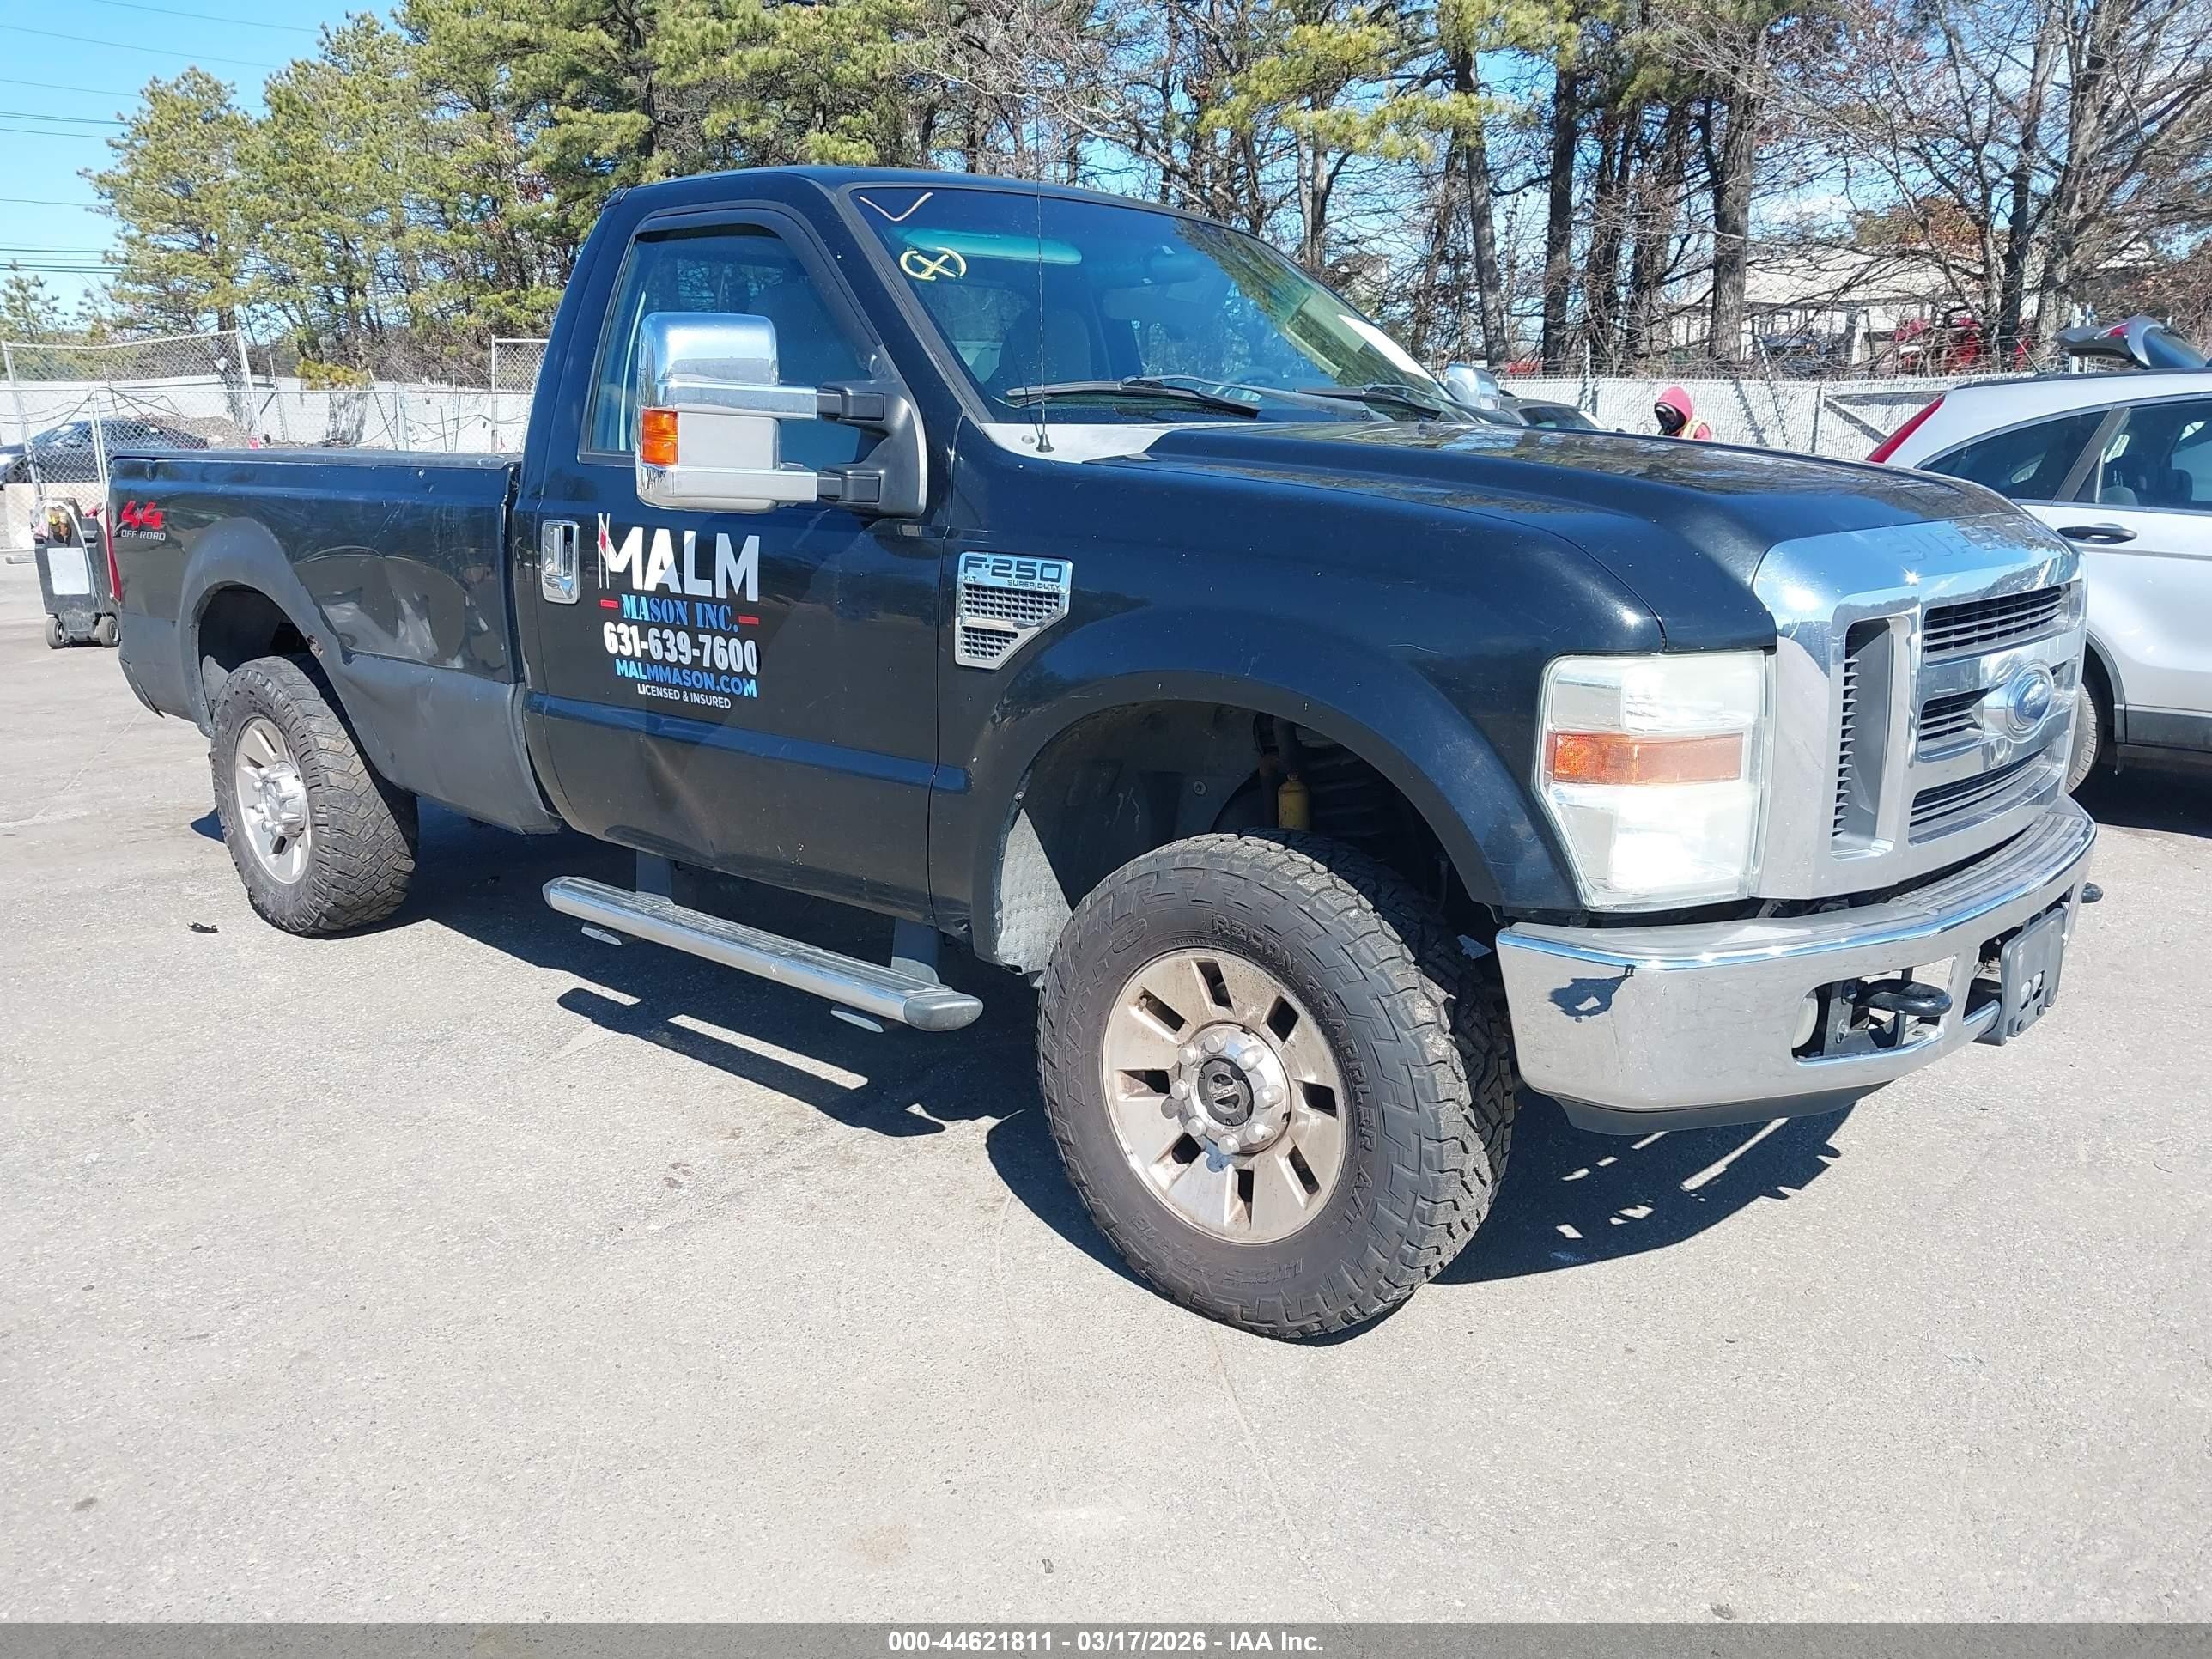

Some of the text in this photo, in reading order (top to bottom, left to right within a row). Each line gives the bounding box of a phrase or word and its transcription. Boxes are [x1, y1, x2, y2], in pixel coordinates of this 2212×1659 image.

[121, 529, 166, 541] OFF ROAD
[598, 513, 760, 602] MALM
[963, 556, 1062, 583] F-250
[1007, 580, 1035, 589] SUPER
[621, 593, 739, 633] MASON INC.
[603, 621, 757, 675] 631-639-7600
[615, 659, 757, 698] MALMMASON.COM
[637, 684, 731, 709] LICENSED & INSURED
